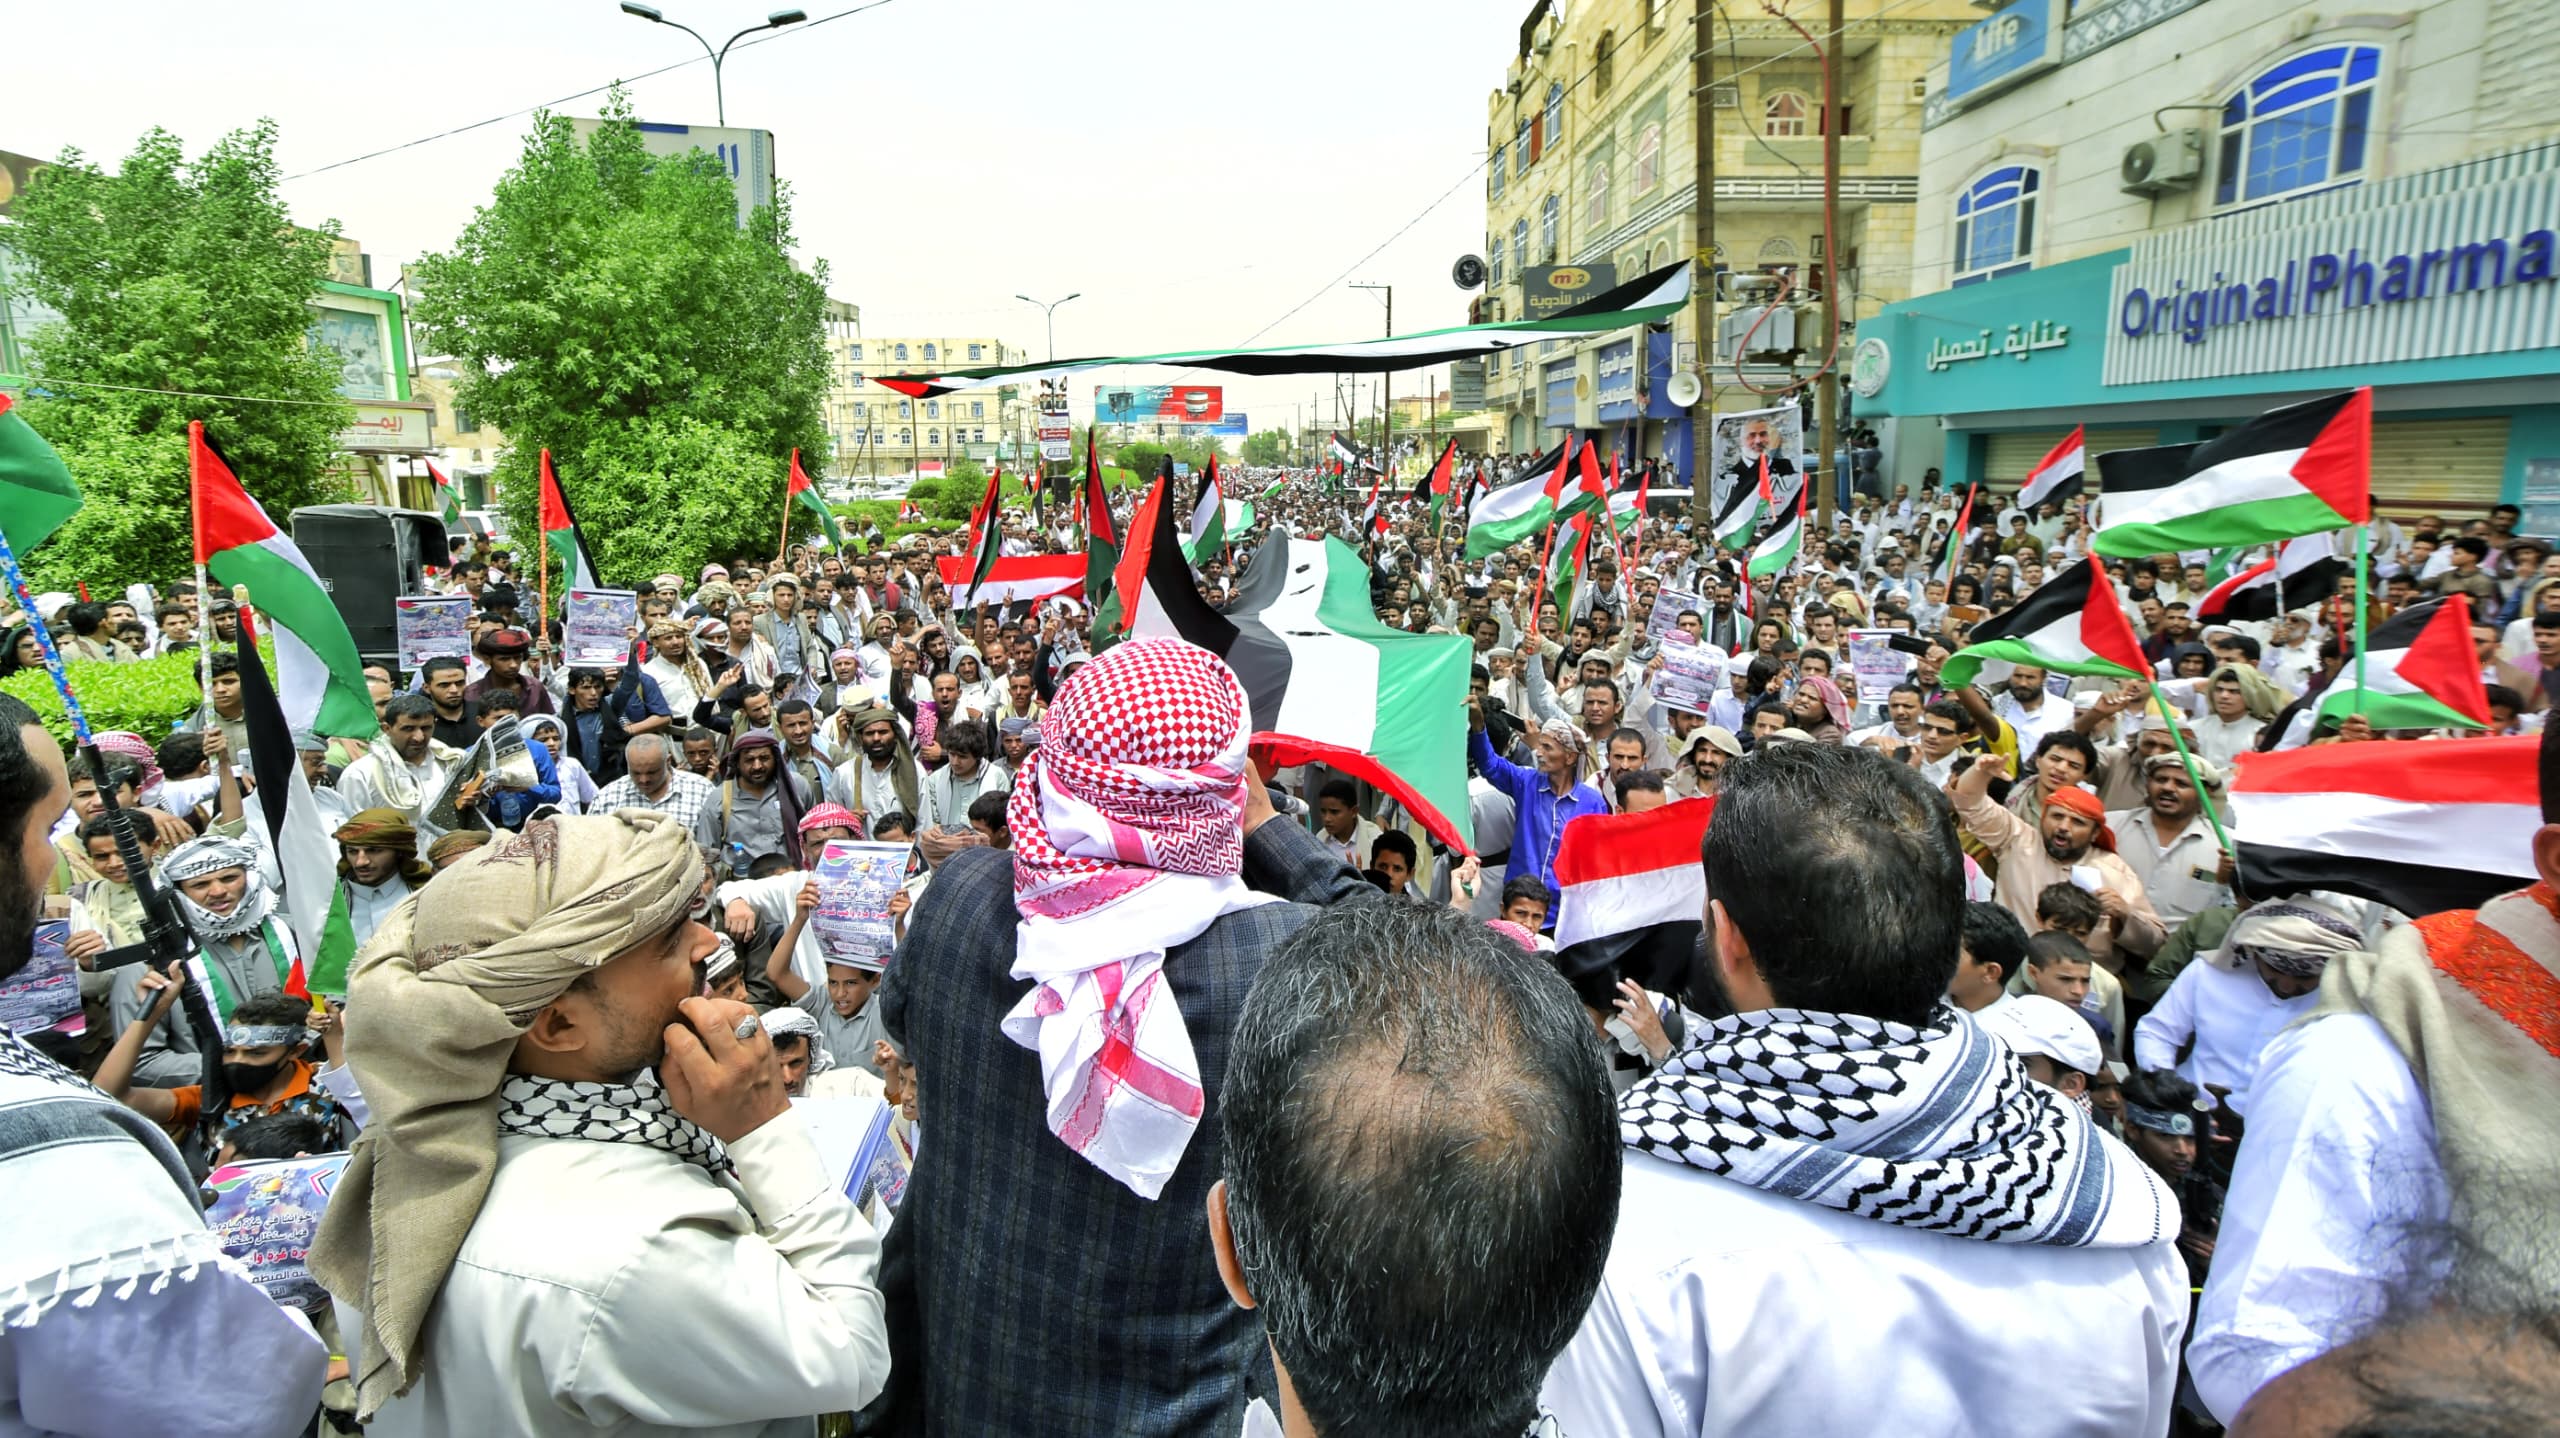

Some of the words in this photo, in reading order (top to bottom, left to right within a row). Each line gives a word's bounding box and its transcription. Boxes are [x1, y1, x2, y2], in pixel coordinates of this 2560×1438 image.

[2122, 260, 2297, 344] Original
[2303, 228, 2555, 314] Pharma
[2004, 320, 2068, 361] عناية
